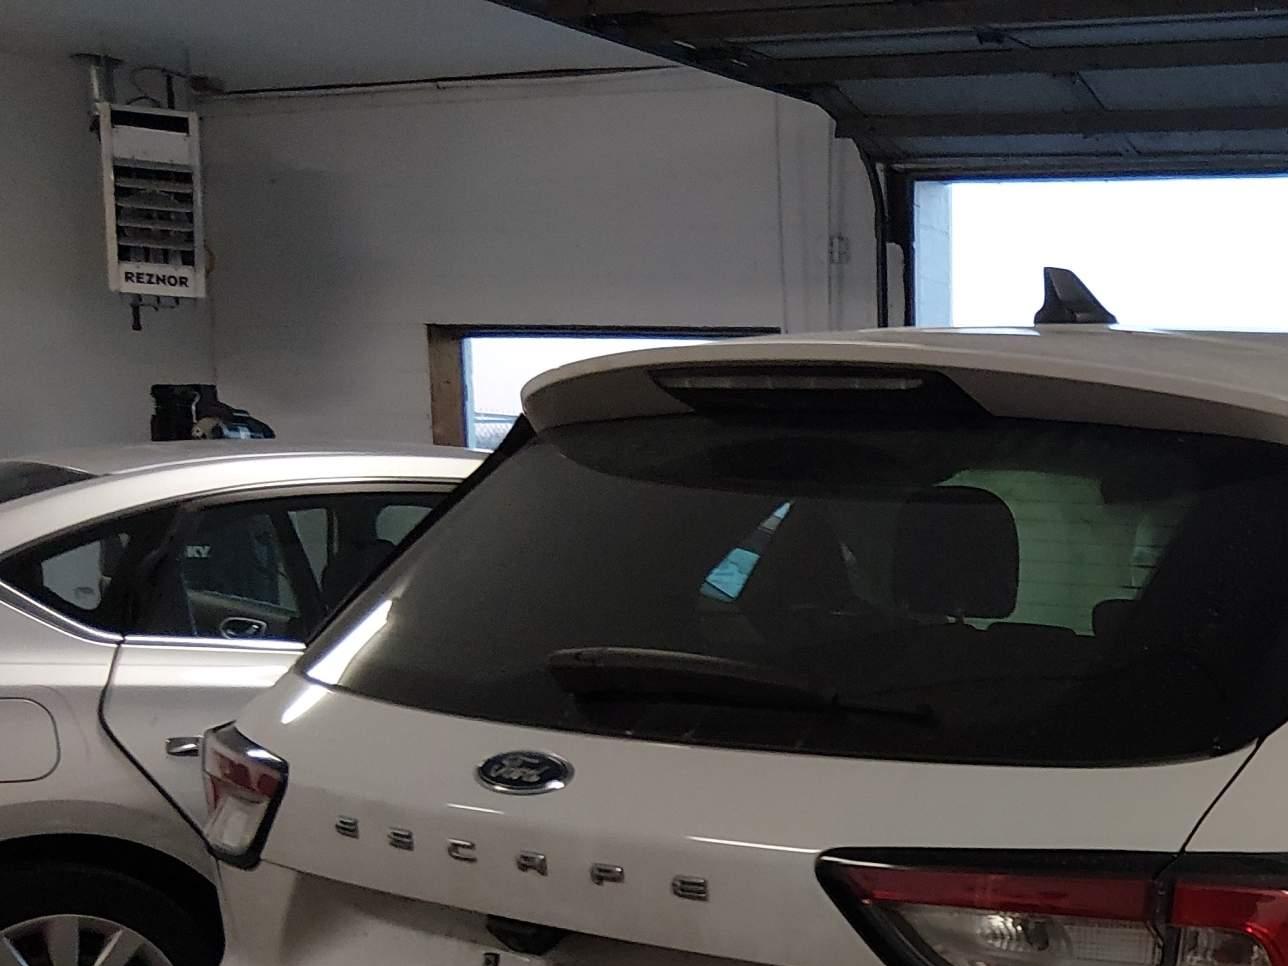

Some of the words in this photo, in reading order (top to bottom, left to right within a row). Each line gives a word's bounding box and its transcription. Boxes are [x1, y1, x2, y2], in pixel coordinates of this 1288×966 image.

[124, 271, 189, 288] REZNOR
[490, 756, 551, 782] Ford
[335, 815, 709, 902] ESCAPE
